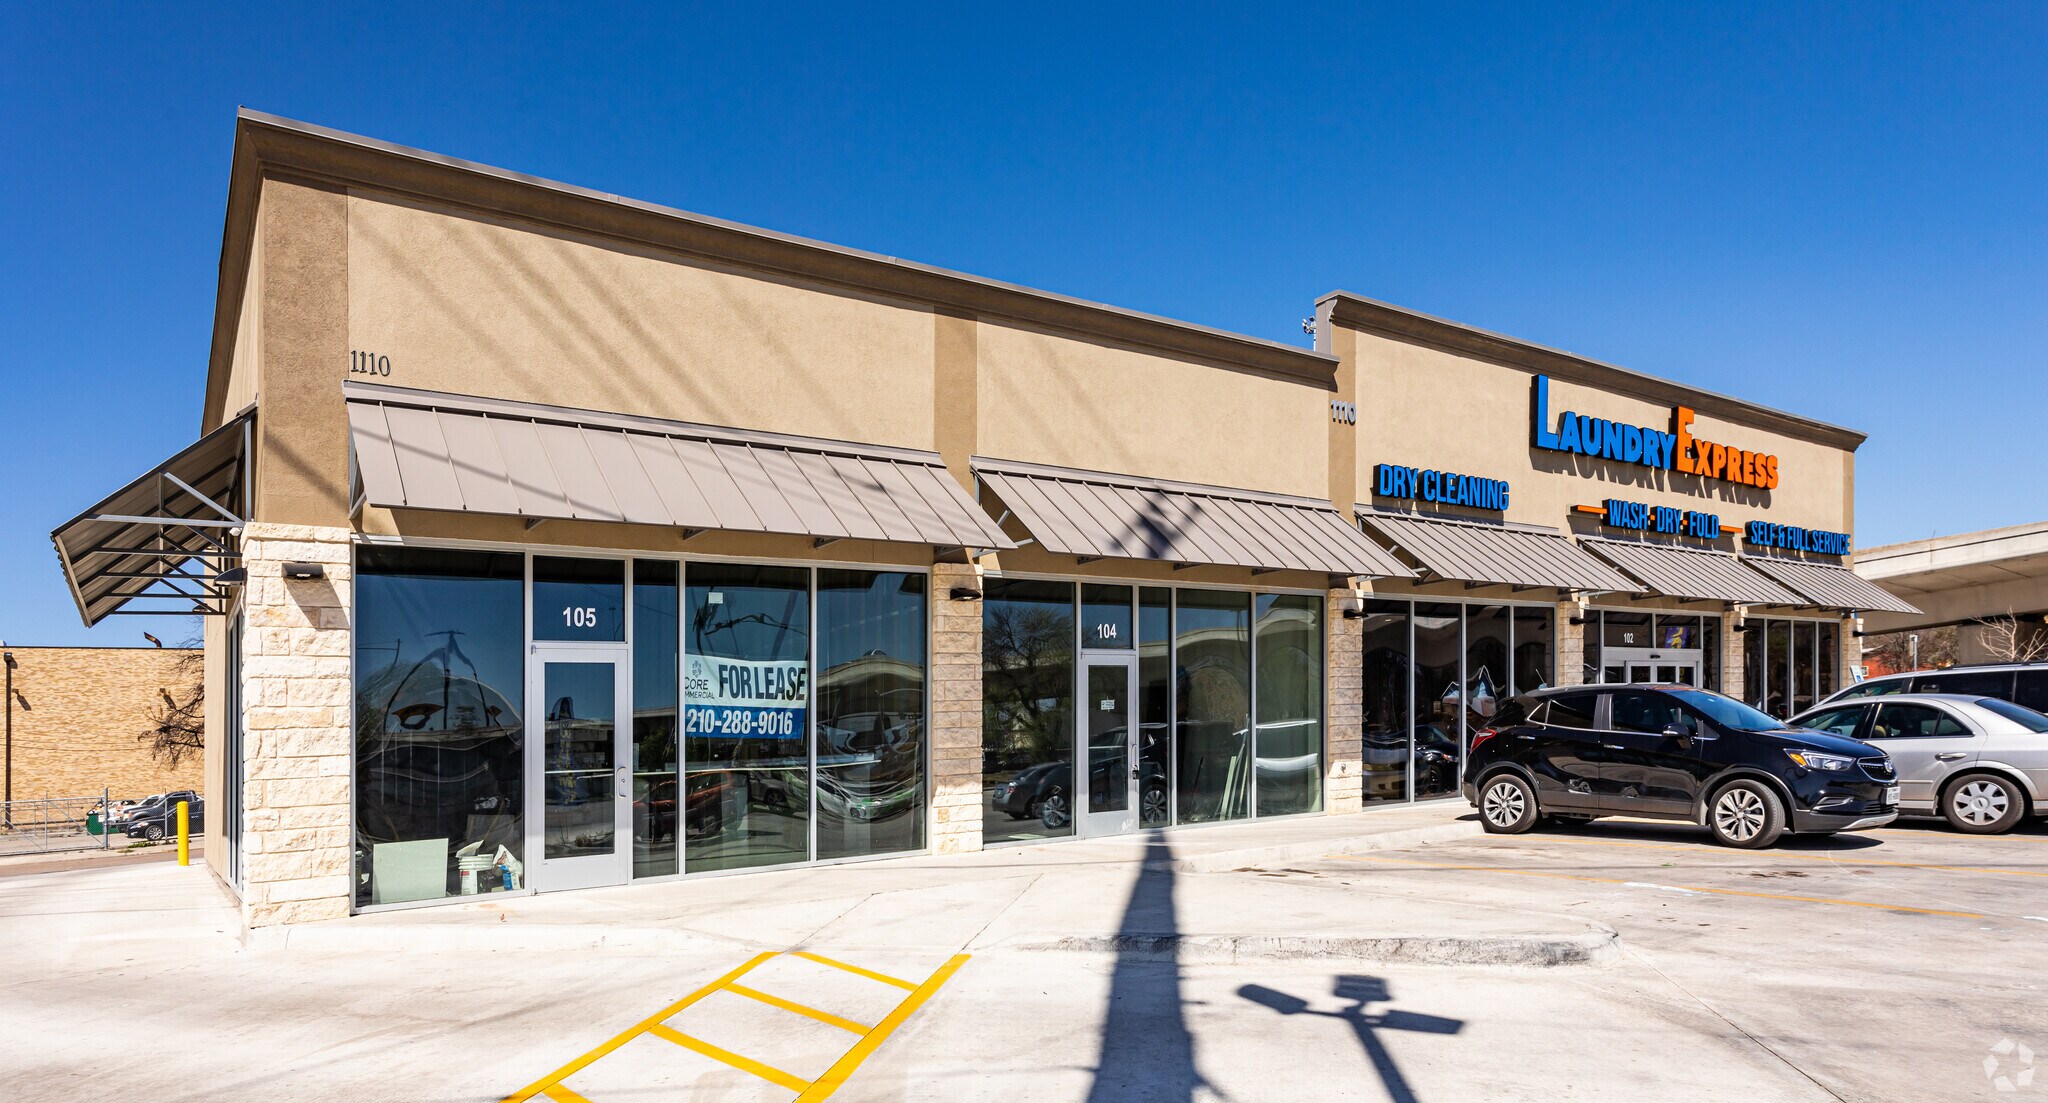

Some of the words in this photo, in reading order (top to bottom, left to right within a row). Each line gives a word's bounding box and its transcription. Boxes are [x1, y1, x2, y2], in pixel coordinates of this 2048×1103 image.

[350, 350, 391, 377] 1110
[1331, 400, 1357, 425] 1110
[1535, 374, 1677, 470] LAUNDRY
[1676, 405, 1779, 490] EXPRESS
[1378, 463, 1418, 499] DRY
[1423, 469, 1510, 511] CLEANING
[1607, 499, 1648, 531] WASH
[1656, 505, 1682, 534] DRY
[1689, 511, 1720, 539] FOLD
[1750, 520, 1776, 546] SELF
[1778, 524, 1785, 547] &
[1787, 526, 1811, 551] FULL
[1812, 530, 1850, 556] SERVICE
[562, 607, 597, 628] 105
[1097, 623, 1117, 639] 104
[1623, 632, 1634, 644] 102
[685, 691, 715, 699] MMERCIAL
[718, 664, 752, 699] FOR
[754, 666, 807, 701] LEASE
[686, 708, 793, 735] 210-288-9016
